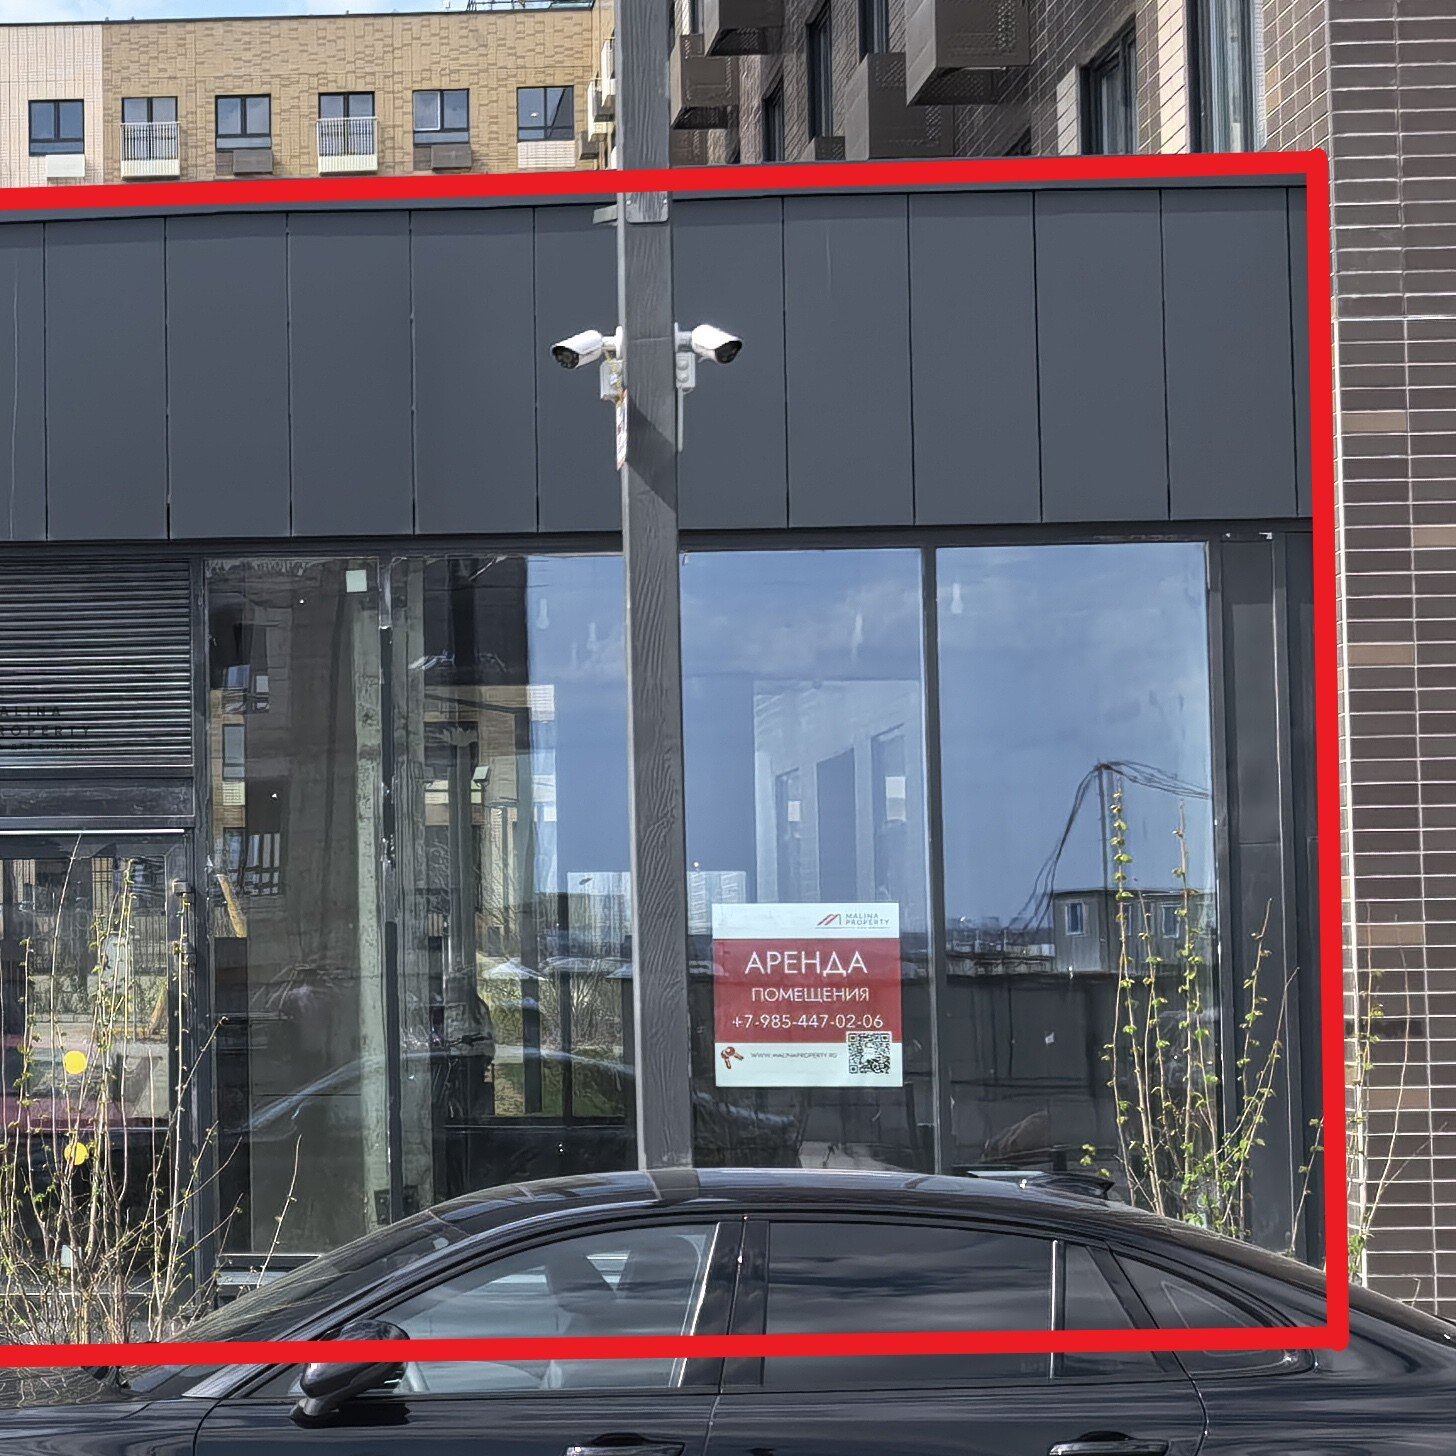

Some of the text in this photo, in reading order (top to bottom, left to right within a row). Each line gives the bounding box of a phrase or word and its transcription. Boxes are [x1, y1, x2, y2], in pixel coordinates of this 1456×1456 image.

[744, 950, 868, 977] АРЕНДА
[751, 987, 870, 1003] ПОМЕЩЕНИЯ
[732, 1014, 884, 1029] +7-985-447-02-06
